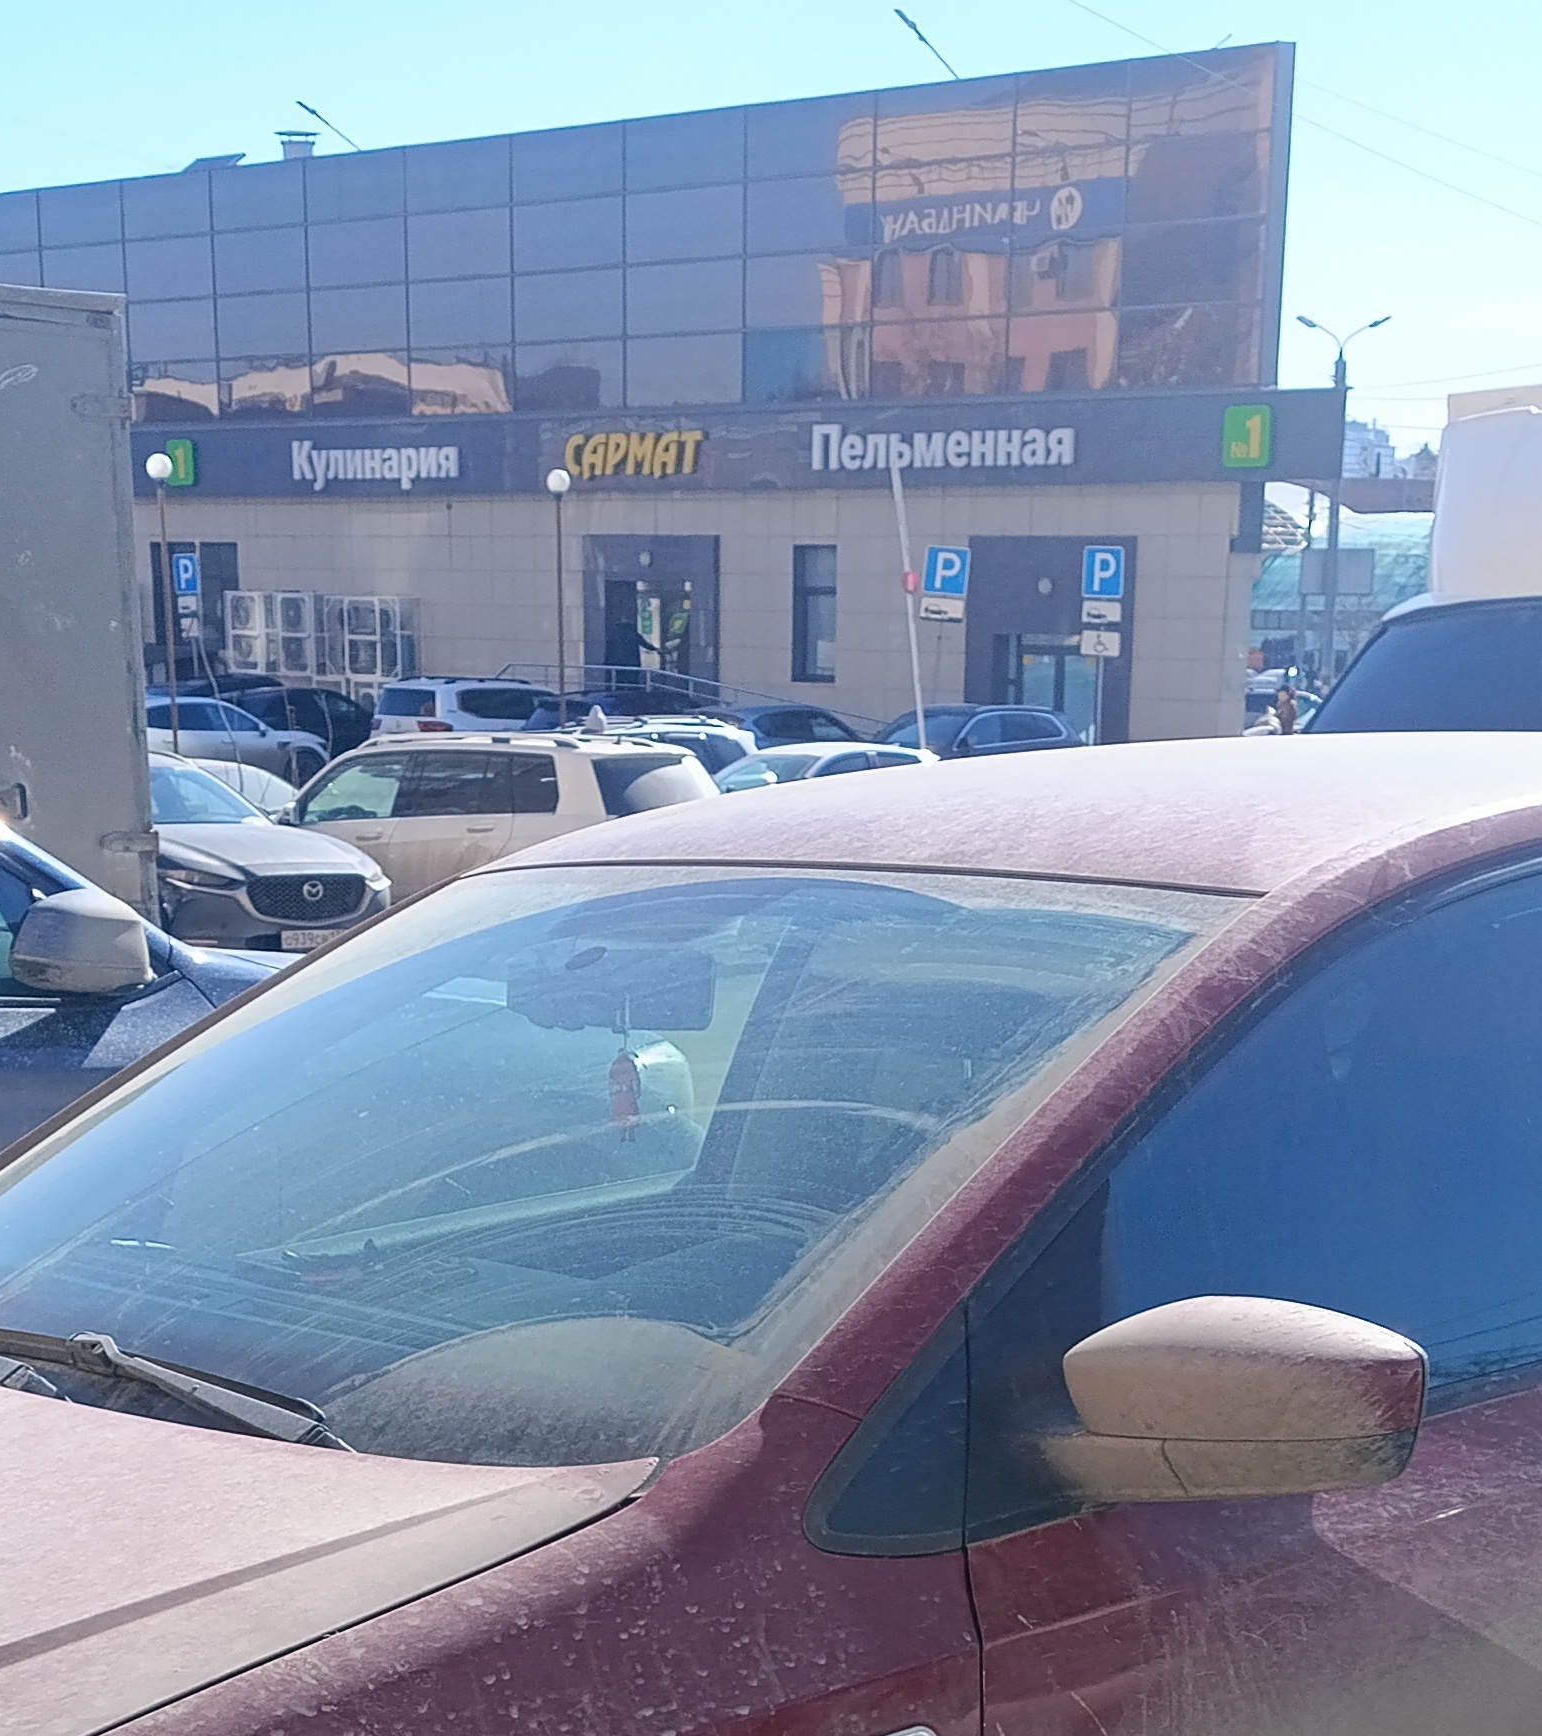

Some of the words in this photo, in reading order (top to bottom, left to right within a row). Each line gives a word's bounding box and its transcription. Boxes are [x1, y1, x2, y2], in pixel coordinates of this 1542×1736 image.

[291, 439, 459, 491] Кулинария
[564, 430, 704, 480] САРМАТ
[811, 423, 1075, 471] Пельменная
